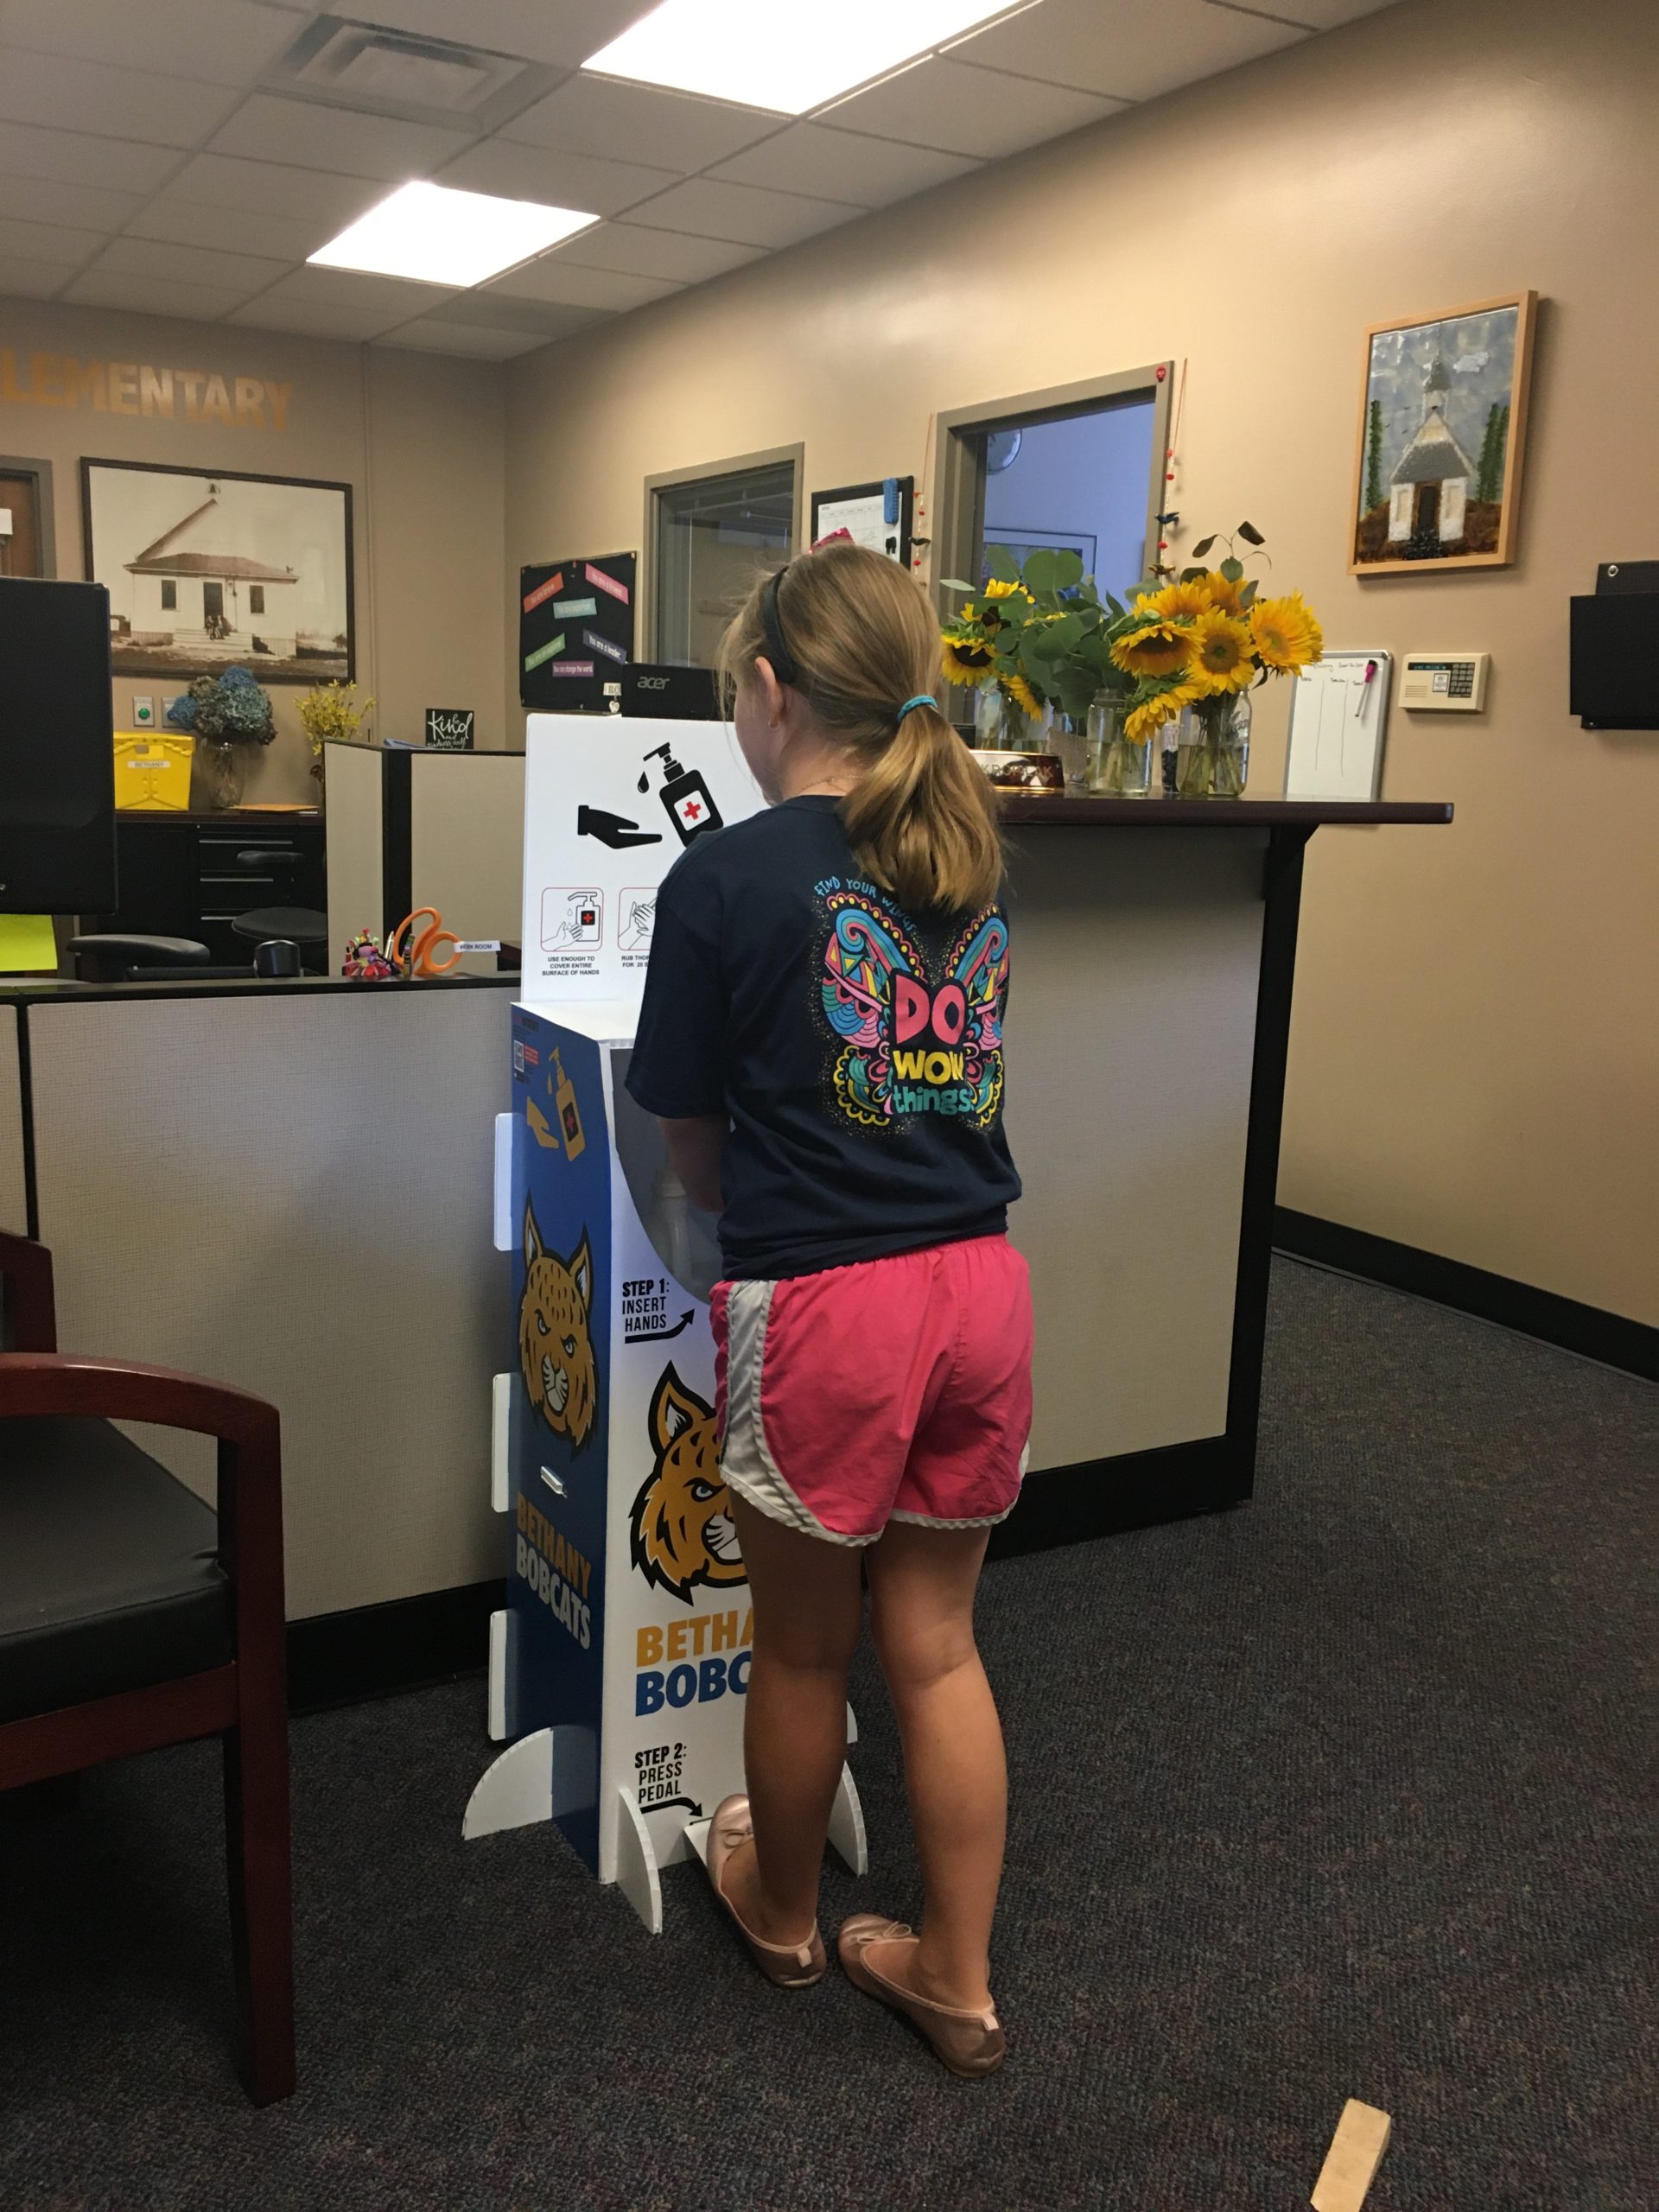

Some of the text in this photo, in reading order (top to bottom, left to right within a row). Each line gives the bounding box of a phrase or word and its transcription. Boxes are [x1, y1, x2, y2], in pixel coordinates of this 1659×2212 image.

[637, 676, 670, 690] acer
[814, 875, 841, 897] FIND
[845, 878, 877, 899] YOUR
[895, 974, 966, 1046] DO
[893, 1050, 964, 1085] WOW
[622, 1278, 671, 1298] STEP 1:
[622, 1296, 667, 1315] INSERT
[625, 1313, 667, 1332] HANDS
[517, 1491, 592, 1599] BETHANY
[516, 1532, 591, 1649] BOBCATS
[634, 1742, 687, 1769] STEP 2:
[639, 1761, 683, 1786] PRESS
[638, 1779, 682, 1805] PEDAL
